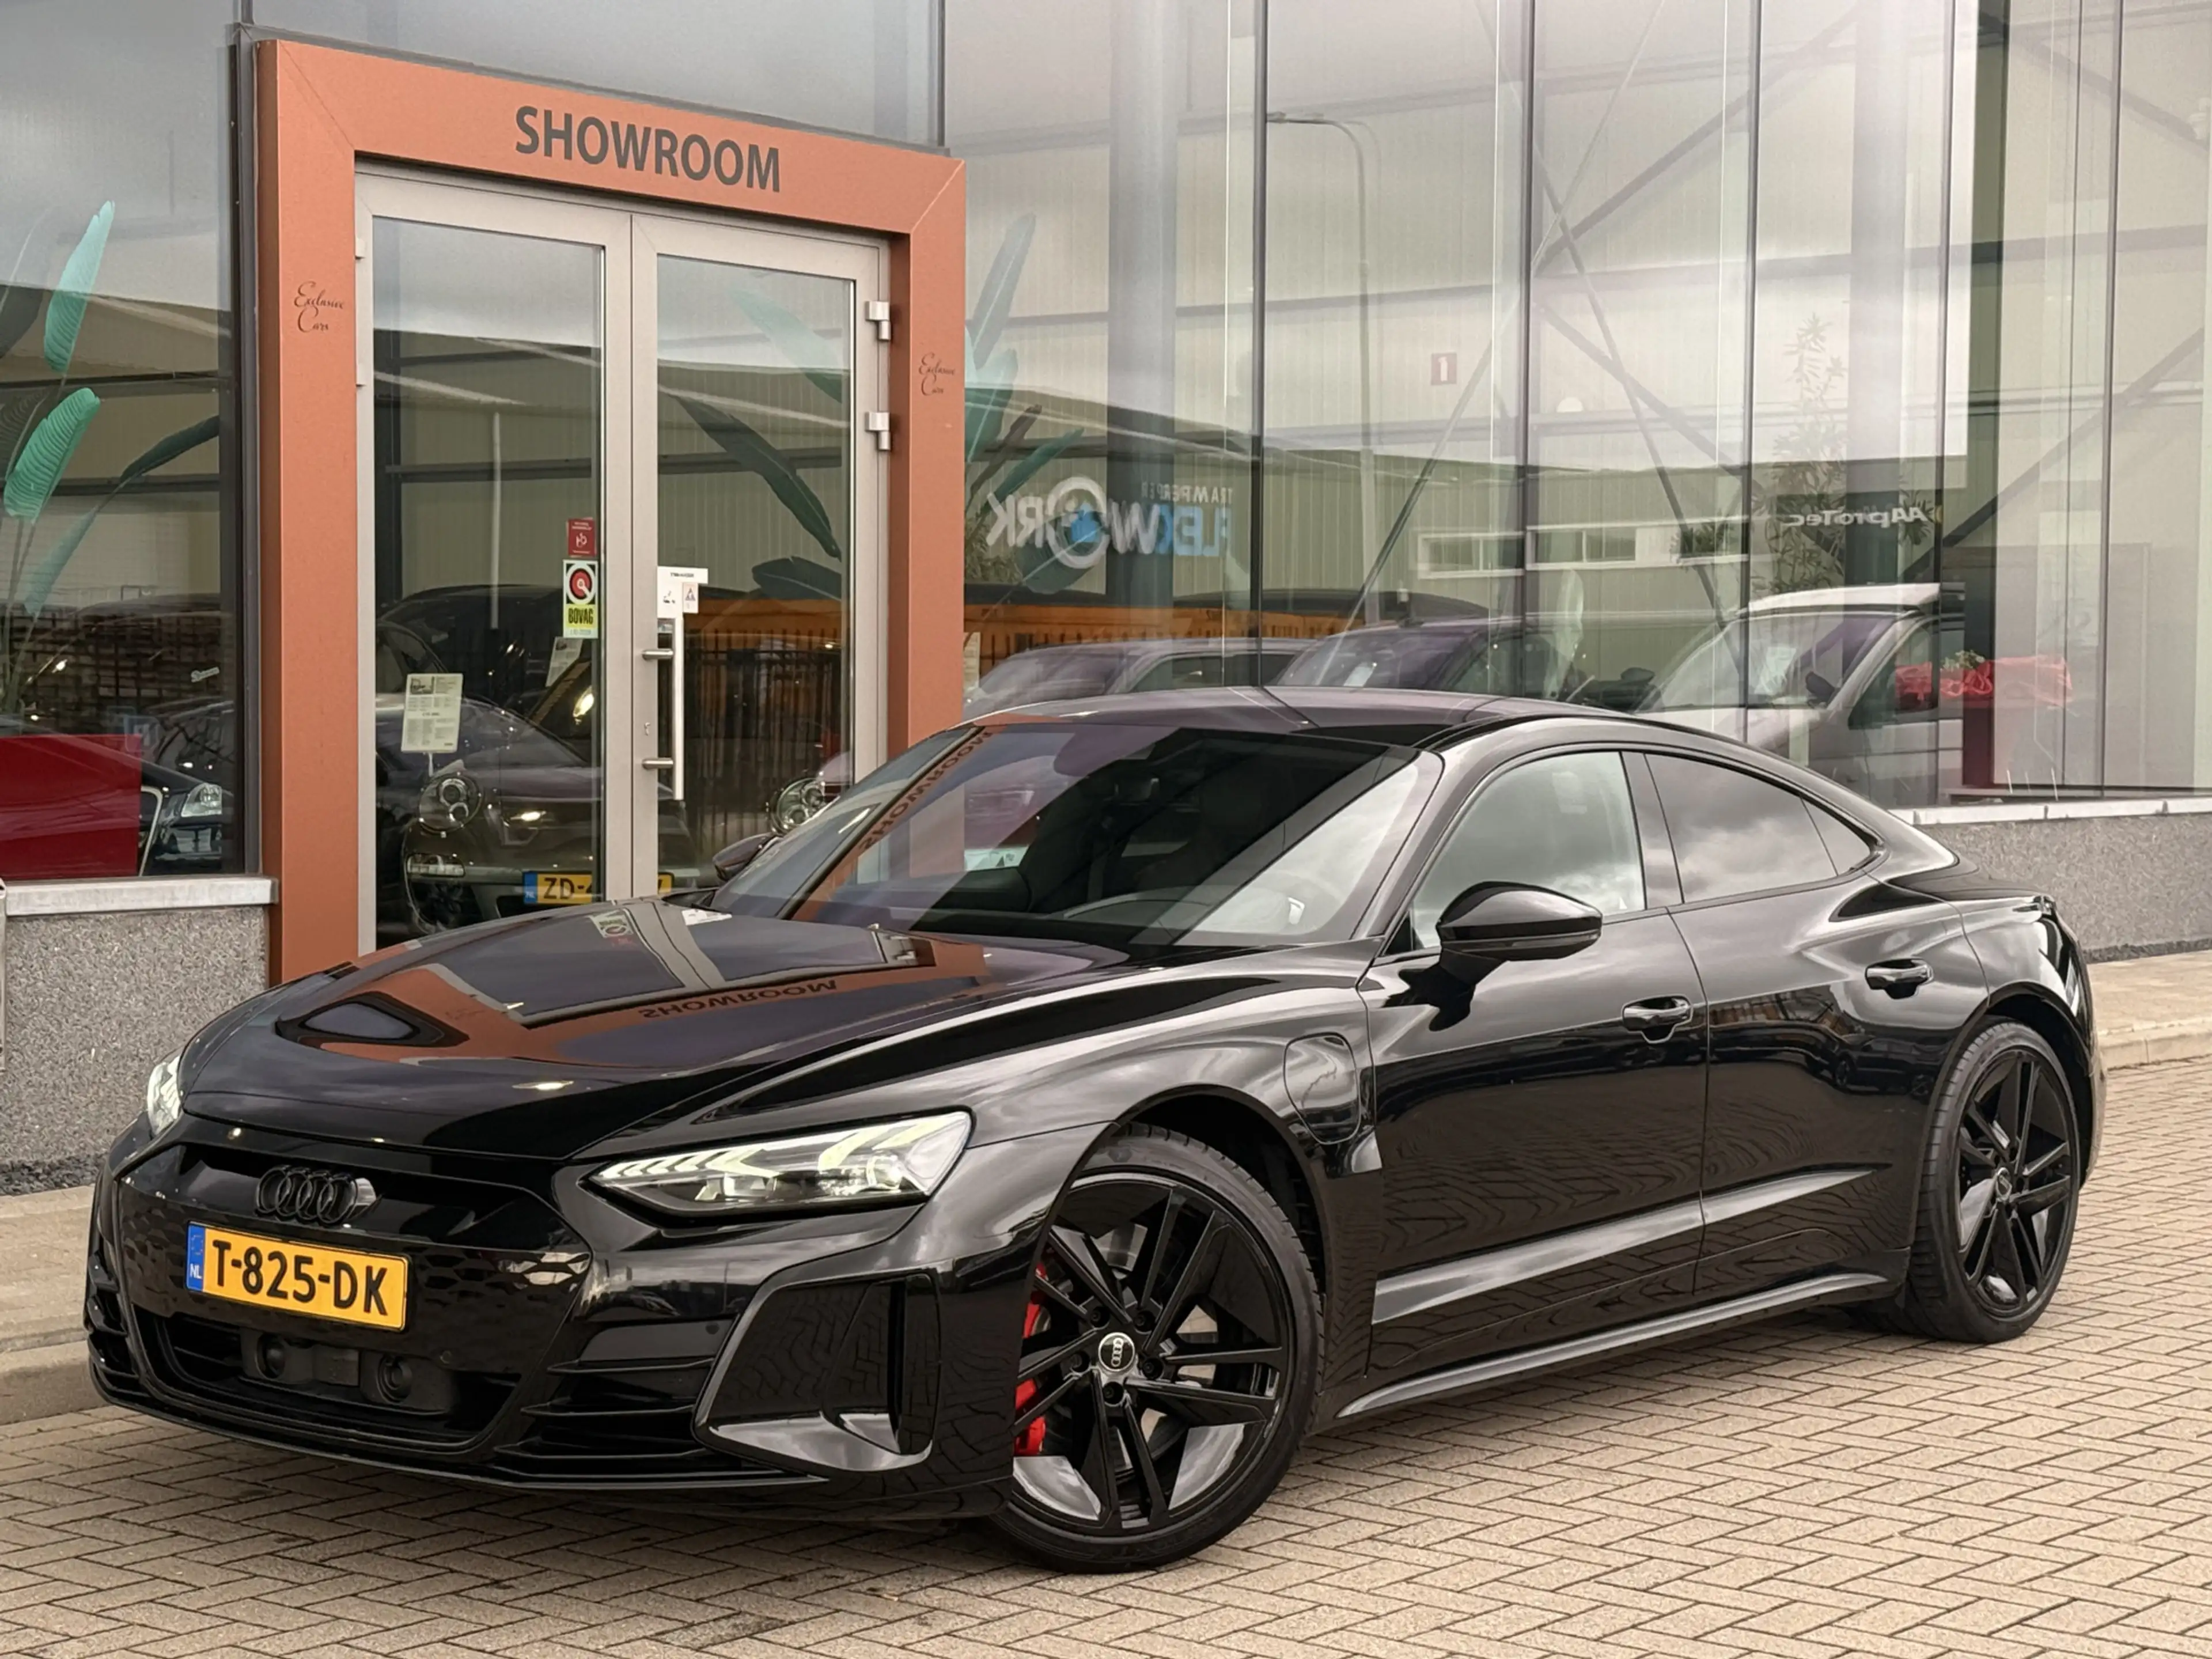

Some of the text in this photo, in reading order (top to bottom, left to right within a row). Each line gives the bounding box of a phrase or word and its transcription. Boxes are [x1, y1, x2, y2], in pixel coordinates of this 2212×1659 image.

[515, 105, 781, 193] SHOWROOM
[293, 280, 344, 309] Exclusive
[297, 305, 329, 333] Cars
[1438, 357, 1448, 381] 1
[568, 608, 594, 624] BOVAG
[190, 1239, 388, 1317] NL T-825-DK
